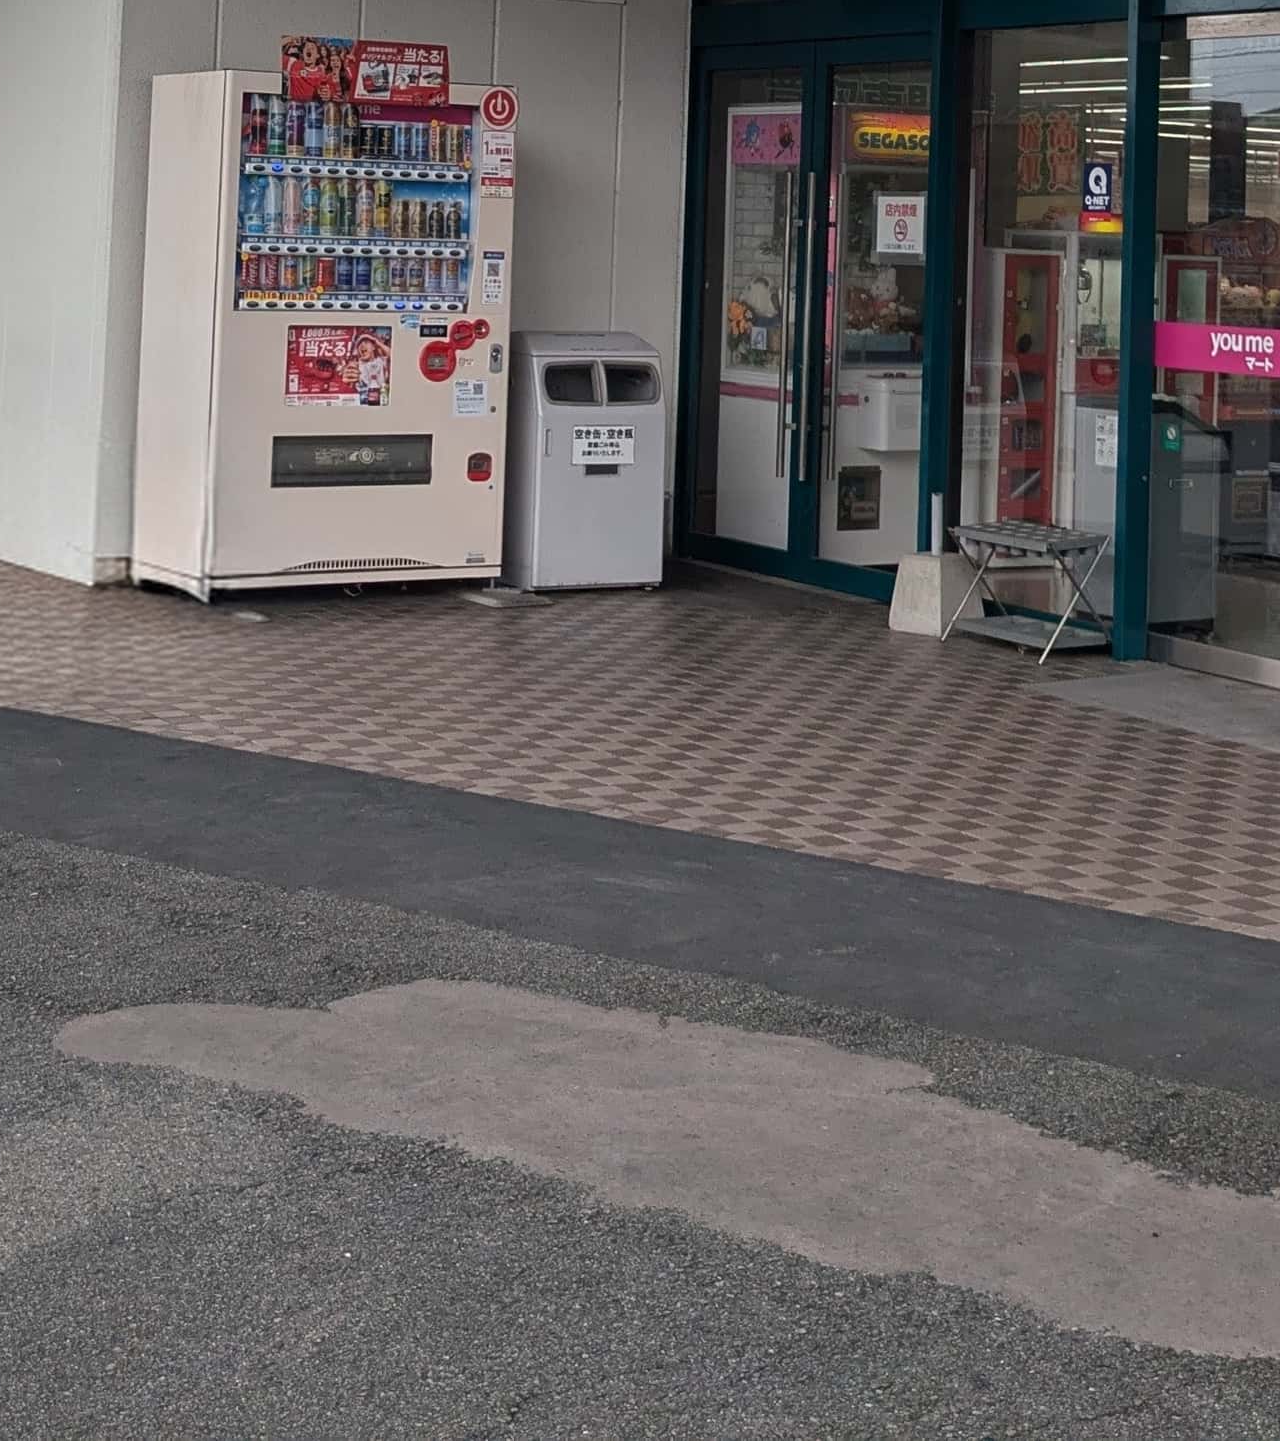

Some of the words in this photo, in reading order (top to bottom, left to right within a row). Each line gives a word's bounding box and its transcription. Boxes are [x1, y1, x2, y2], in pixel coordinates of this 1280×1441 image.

[403, 47, 444, 64] 当たる!
[305, 341, 352, 357] 当たる!
[1245, 356, 1274, 373] マート
